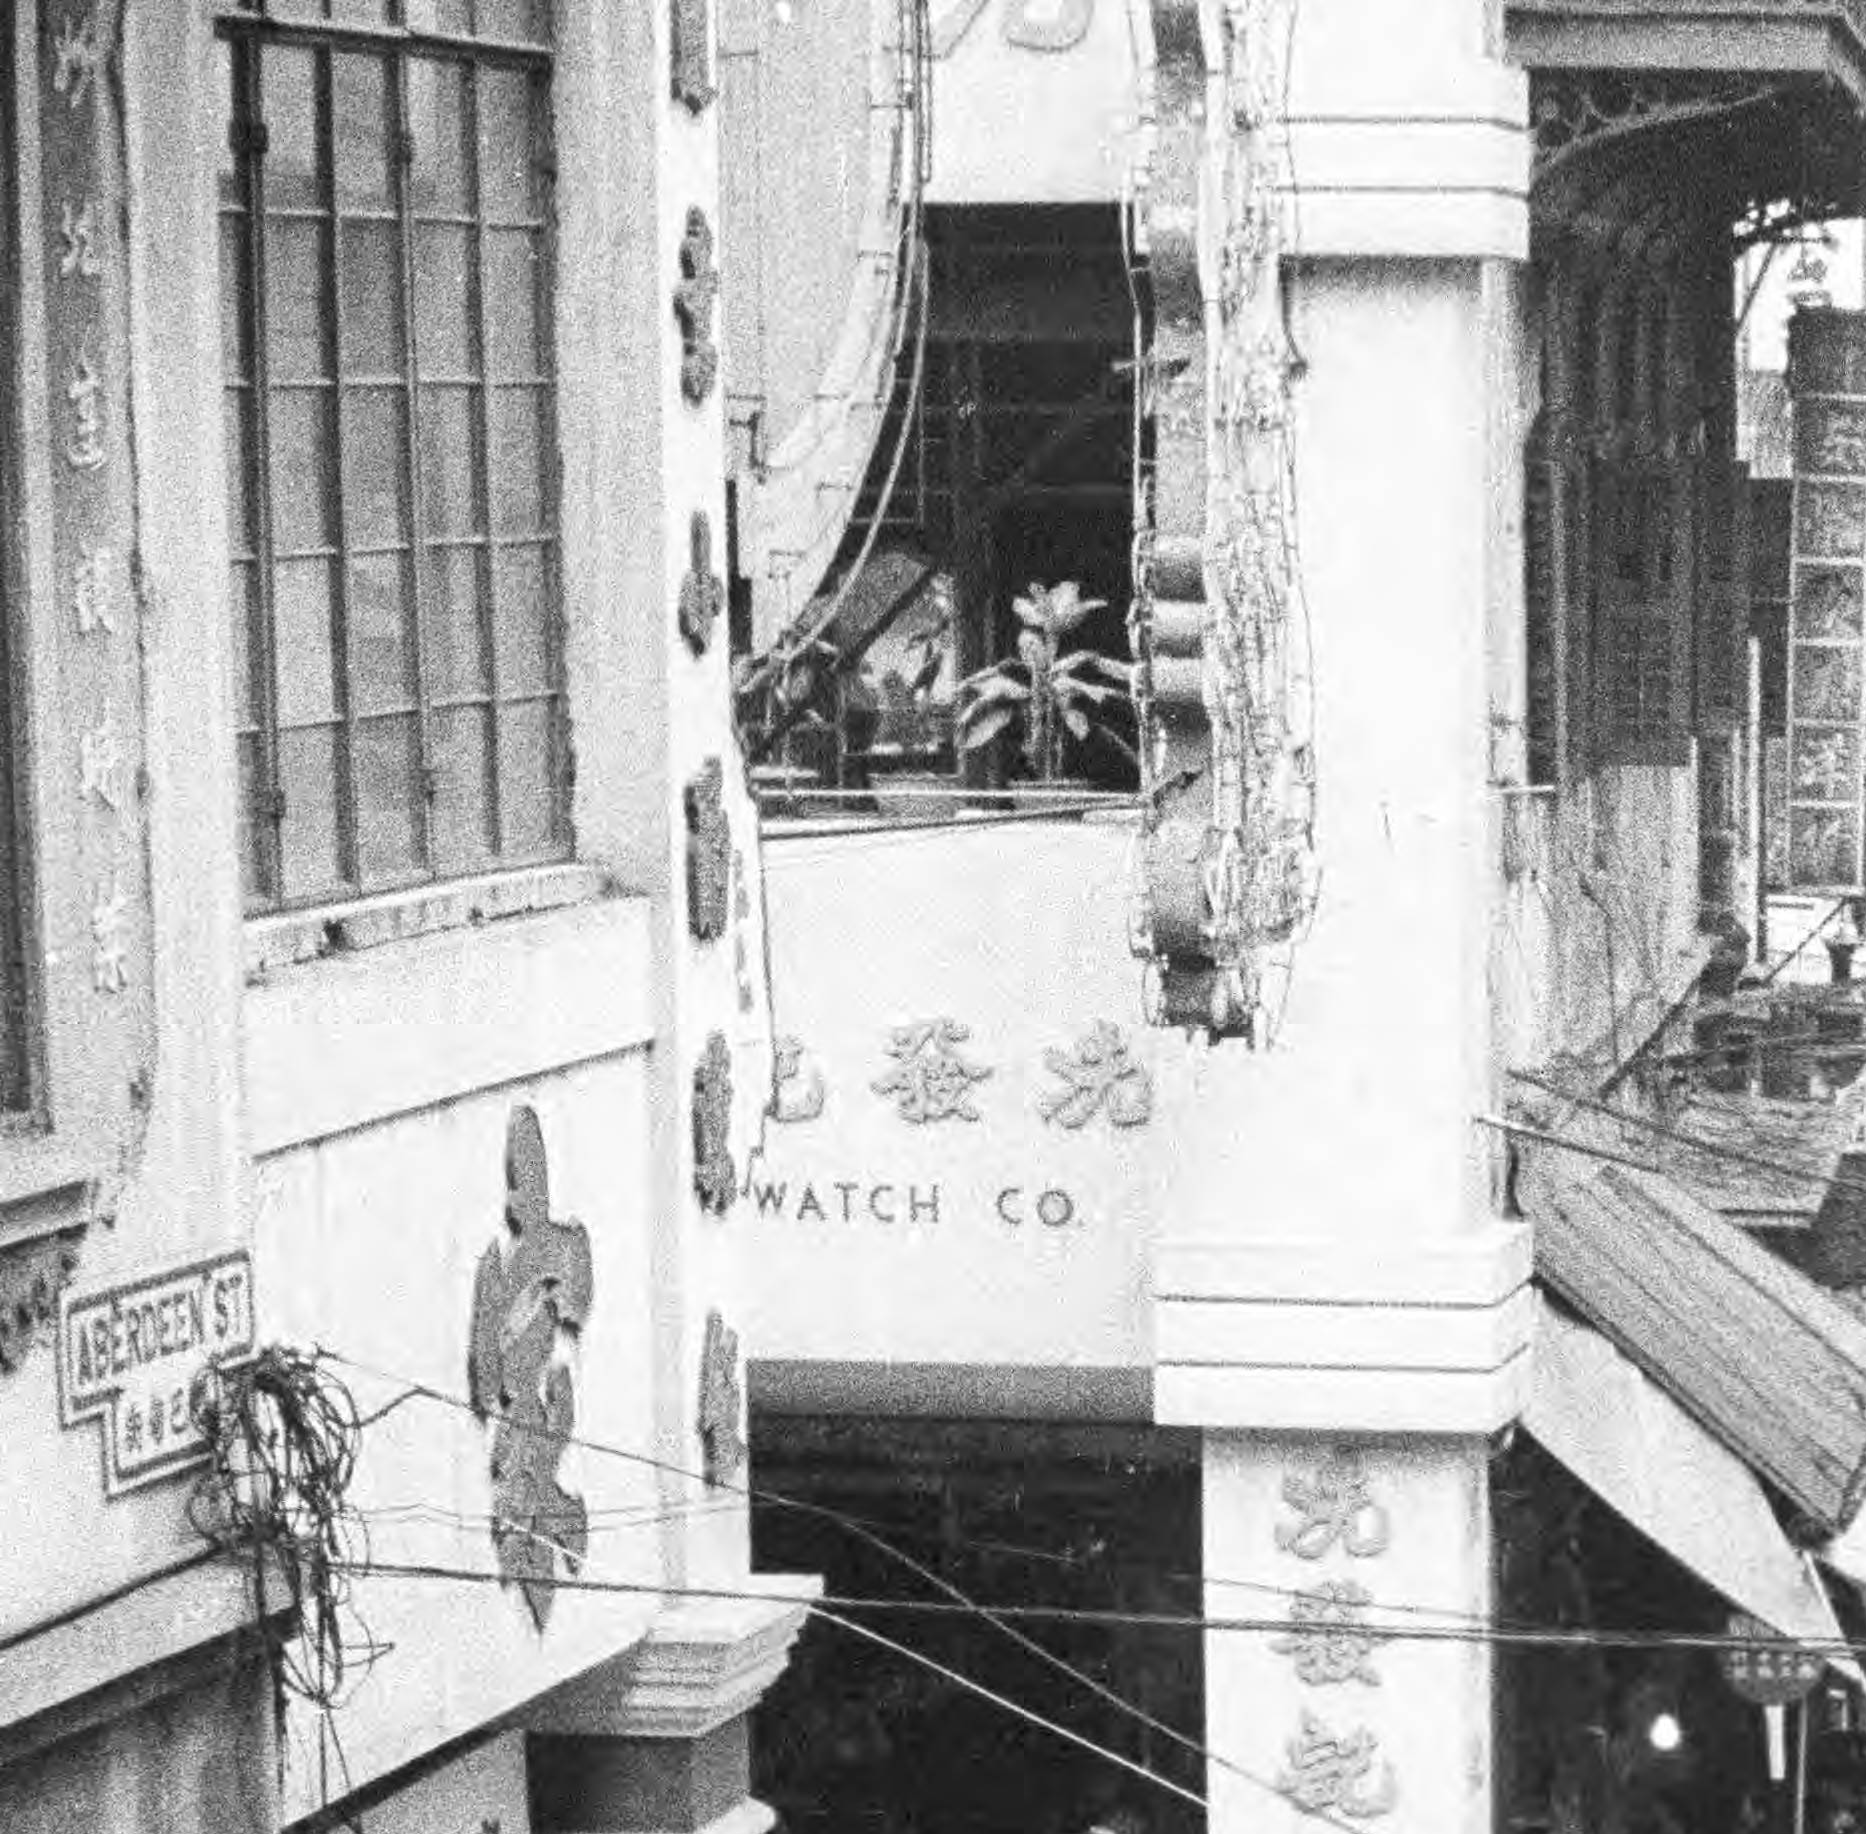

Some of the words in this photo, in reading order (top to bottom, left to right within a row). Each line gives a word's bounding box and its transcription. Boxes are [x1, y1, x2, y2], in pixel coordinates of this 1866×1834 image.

[753, 1182, 941, 1226] WATCH
[76, 1289, 205, 1386] ABERDEEN
[214, 1272, 244, 1340] ST
